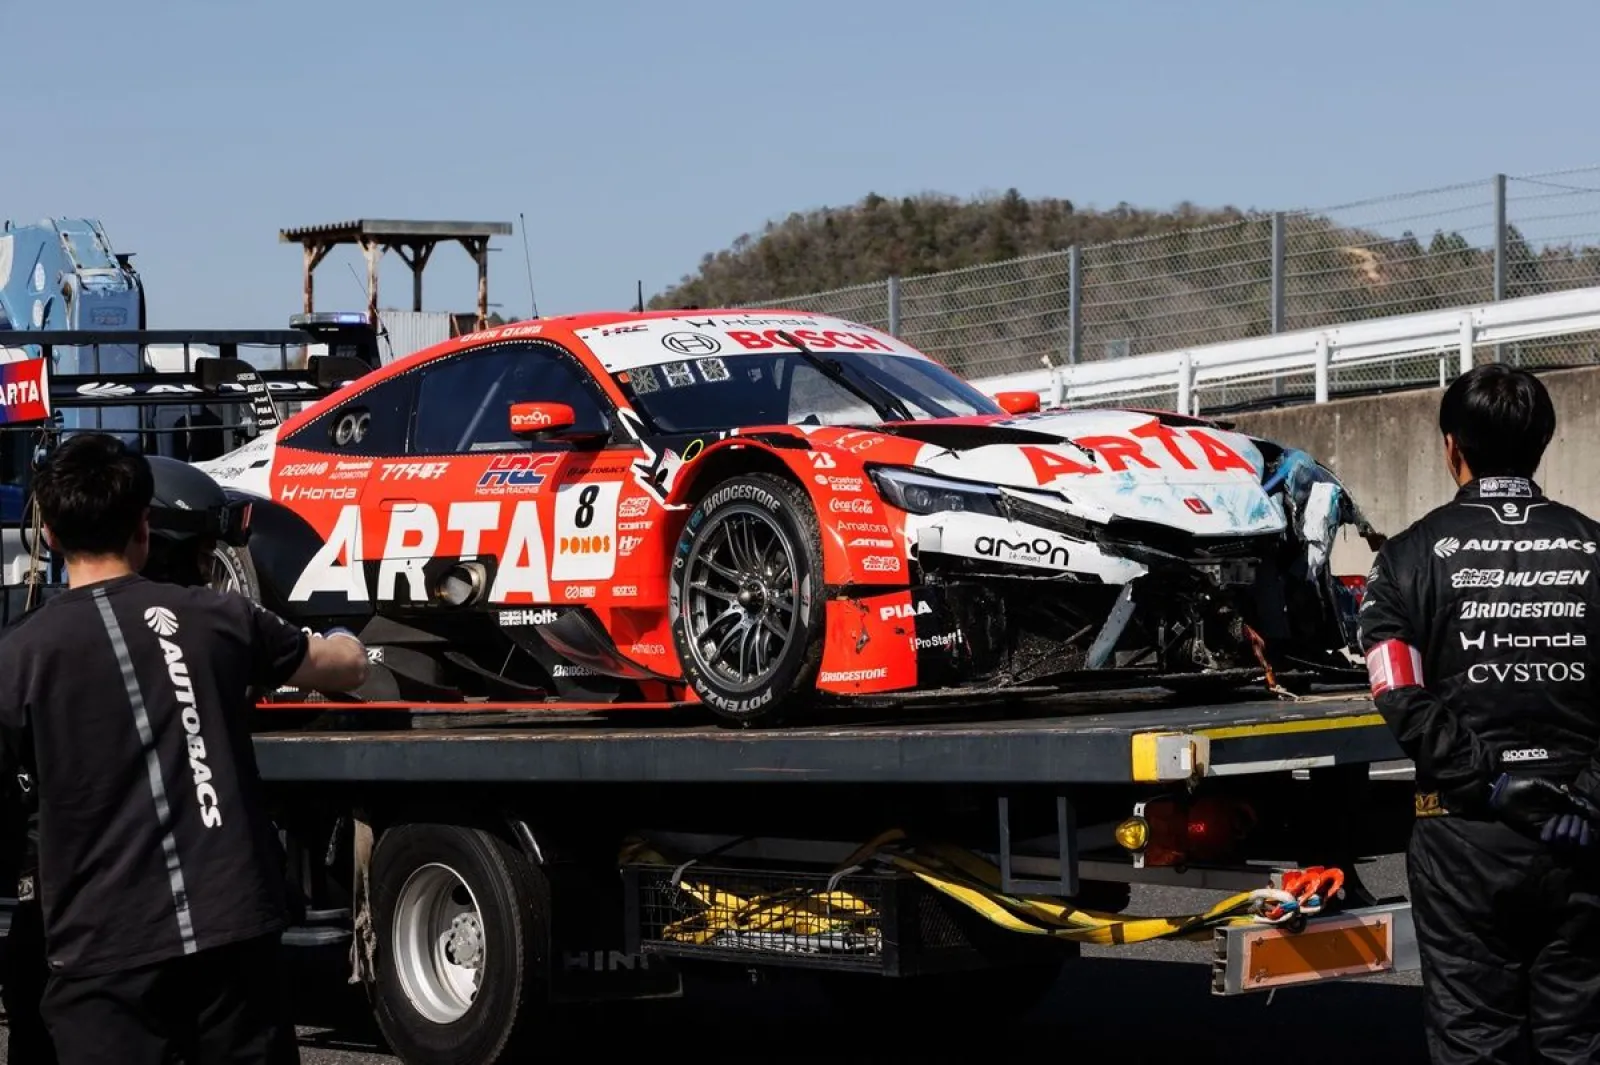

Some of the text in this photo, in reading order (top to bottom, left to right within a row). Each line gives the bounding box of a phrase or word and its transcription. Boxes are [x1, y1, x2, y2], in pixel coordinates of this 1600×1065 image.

[726, 330, 895, 353] BOSCH
[0, 380, 39, 405] ARTA
[511, 411, 551, 425] amon
[1018, 420, 1258, 486] ARTA
[336, 460, 373, 470] Panasonic
[479, 455, 560, 486] HRC
[299, 486, 357, 500] Honda
[475, 487, 505, 495] Honda
[703, 484, 781, 517] BRIDGESTONE
[575, 485, 600, 529] 8
[288, 500, 551, 603] ARTA
[560, 536, 610, 555] PONOS
[974, 536, 1069, 566] amon
[1462, 537, 1597, 554] AUTOBACS
[1504, 570, 1590, 586] MUGEN
[522, 609, 557, 625] Holts
[879, 600, 932, 621] PIAA
[1460, 600, 1587, 619] BRIDGESTONE
[1493, 632, 1587, 648] Honda
[820, 668, 888, 683] BRIDGESTONE
[1467, 662, 1586, 683] CVSTOS
[695, 680, 773, 714] POTENZA
[158, 636, 222, 828] AUTOBACS
[1502, 748, 1548, 761] sparco
[563, 950, 649, 971] HIN
